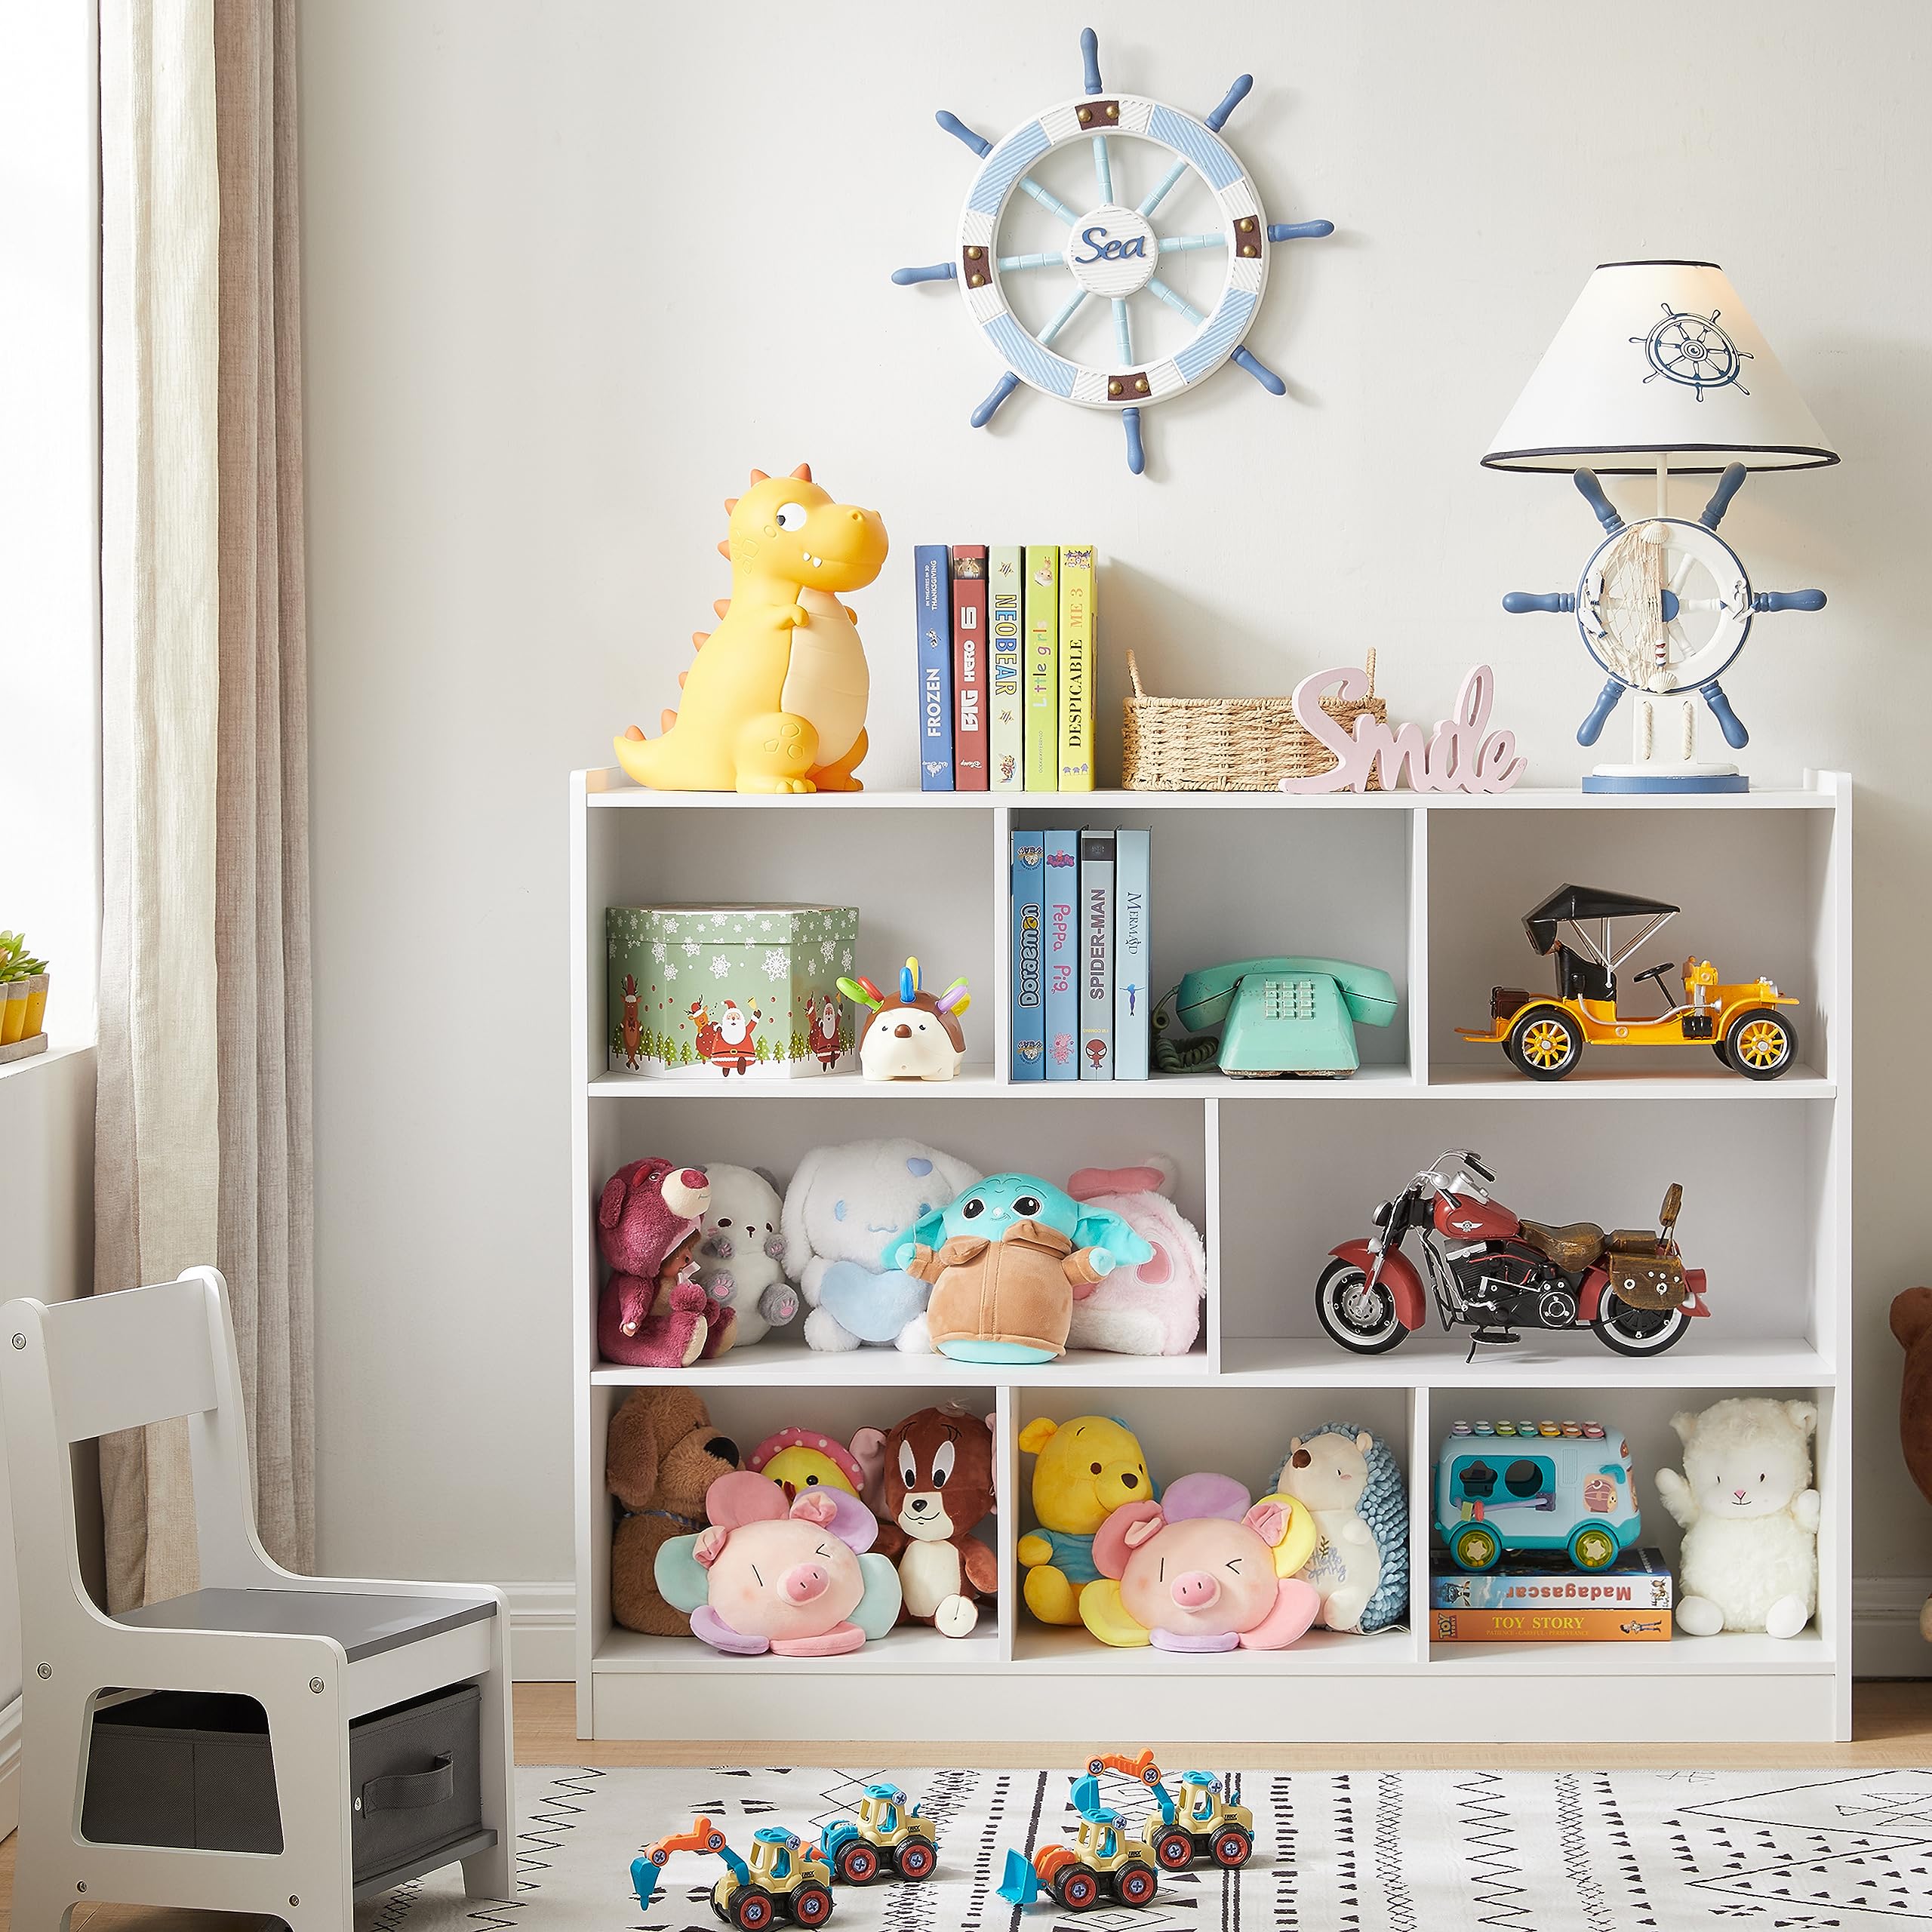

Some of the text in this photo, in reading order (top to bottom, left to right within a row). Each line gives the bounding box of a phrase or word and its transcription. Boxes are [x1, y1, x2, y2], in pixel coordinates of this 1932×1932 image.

[1075, 227, 1146, 264] Sea
[961, 606, 979, 731] BIG HERO 6
[995, 594, 1017, 696] NEOBEAR
[1069, 588, 1083, 748] DESPICABLE ME 3
[927, 668, 942, 737] FROZEN
[1278, 664, 1527, 794] Smile
[1018, 902, 1041, 1009] Doraemon
[1051, 904, 1072, 995] Peppa Pig
[1090, 888, 1106, 1001] SPIDER-MAN
[1438, 1612, 1453, 1639] TOY
[1492, 1617, 1585, 1629] TOY STORY
[1506, 1583, 1632, 1601] Madagascar
